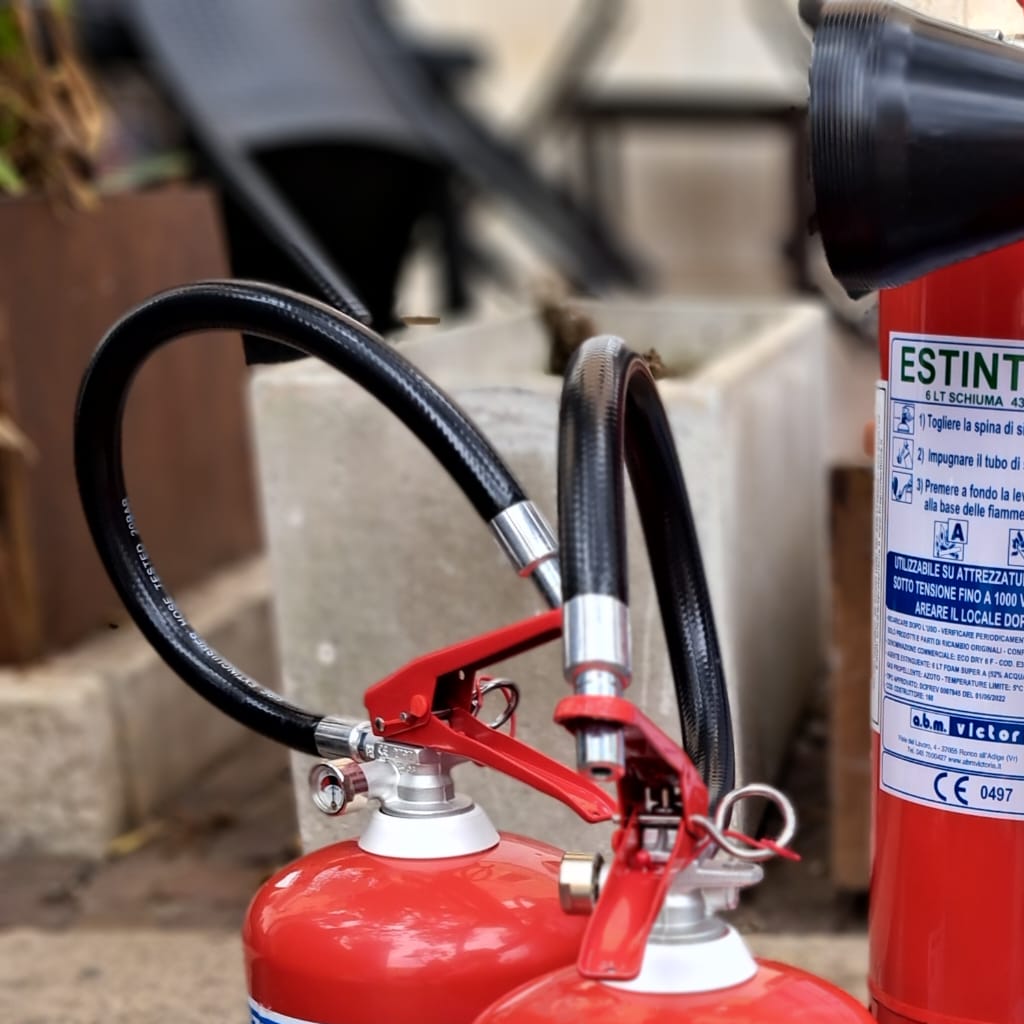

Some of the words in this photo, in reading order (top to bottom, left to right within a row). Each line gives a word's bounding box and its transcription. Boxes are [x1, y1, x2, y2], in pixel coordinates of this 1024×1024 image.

[933, 391, 946, 402] LT
[948, 391, 1004, 407] SCHIUMA
[927, 413, 962, 434] Togliere
[963, 417, 972, 431] la
[974, 421, 1001, 437] spina
[1004, 421, 1014, 436] di
[917, 447, 925, 462] 2)
[928, 448, 974, 468] Impugnare
[976, 452, 982, 467] il
[984, 454, 1008, 470] tubo
[1010, 455, 1020, 470] di
[924, 478, 959, 496] Premere
[970, 483, 998, 500] fondo
[1000, 486, 1010, 501] la
[924, 500, 938, 512] alla
[940, 501, 960, 515] base
[963, 502, 986, 518] delle
[950, 524, 964, 542] A
[135, 542, 163, 591] TESTED
[894, 556, 940, 578] UTILIZZABILE
[942, 566, 954, 580] SU
[893, 576, 914, 593] SOTTO
[916, 580, 956, 600] TENSIONE
[958, 587, 982, 604] FINO
[984, 591, 992, 605] A
[994, 590, 1017, 608] 1000
[162, 596, 187, 627] HOSE
[914, 601, 948, 620] AREARE
[950, 606, 959, 621] IL
[961, 608, 1000, 626] LOCALE
[970, 644, 1002, 654] ORIGINALI
[912, 713, 948, 733] a.b.m.
[980, 785, 1014, 802] 0497
